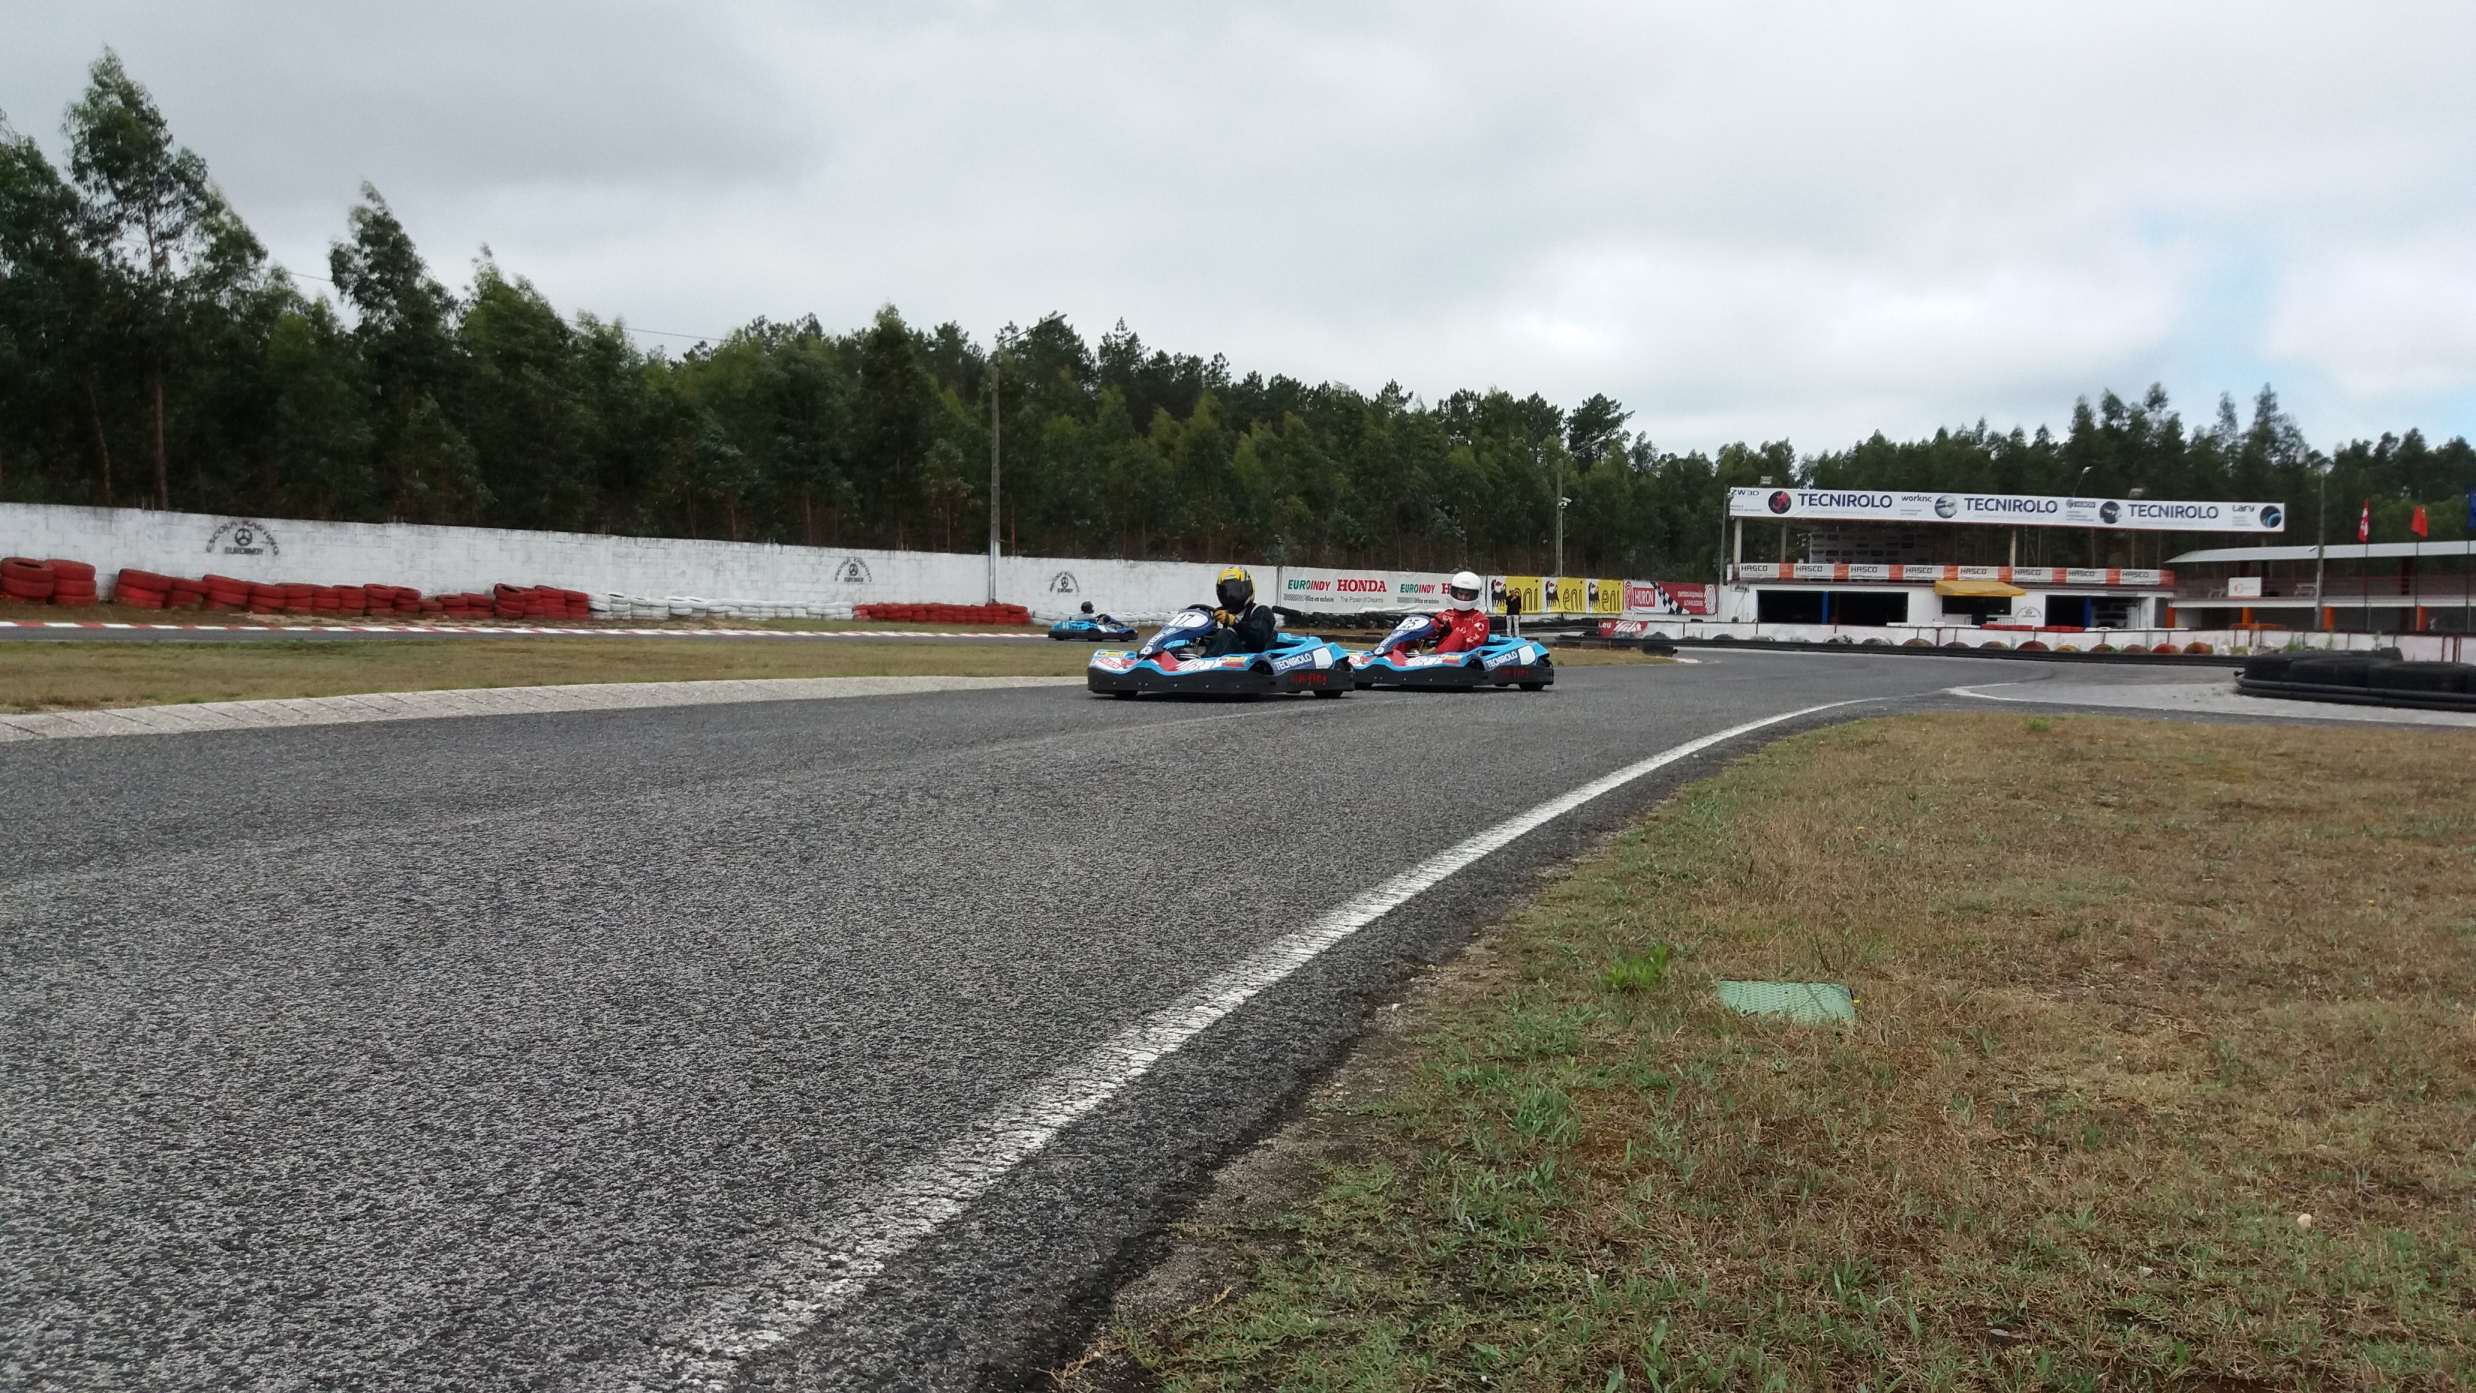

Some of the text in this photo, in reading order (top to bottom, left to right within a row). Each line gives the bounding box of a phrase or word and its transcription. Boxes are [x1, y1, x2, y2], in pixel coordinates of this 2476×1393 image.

[1798, 493, 1893, 508] TECNIROLO
[1964, 497, 2058, 514] TECNIROLO
[2128, 504, 2219, 519] TECNIROLO
[1796, 565, 1823, 573] HASCO
[2122, 570, 2149, 578] HASCO
[1288, 579, 1387, 593] EUROINDY HONDA
[1400, 583, 1436, 594] EUROINDY
[1563, 580, 1582, 611] eni
[1601, 582, 1621, 611] eni
